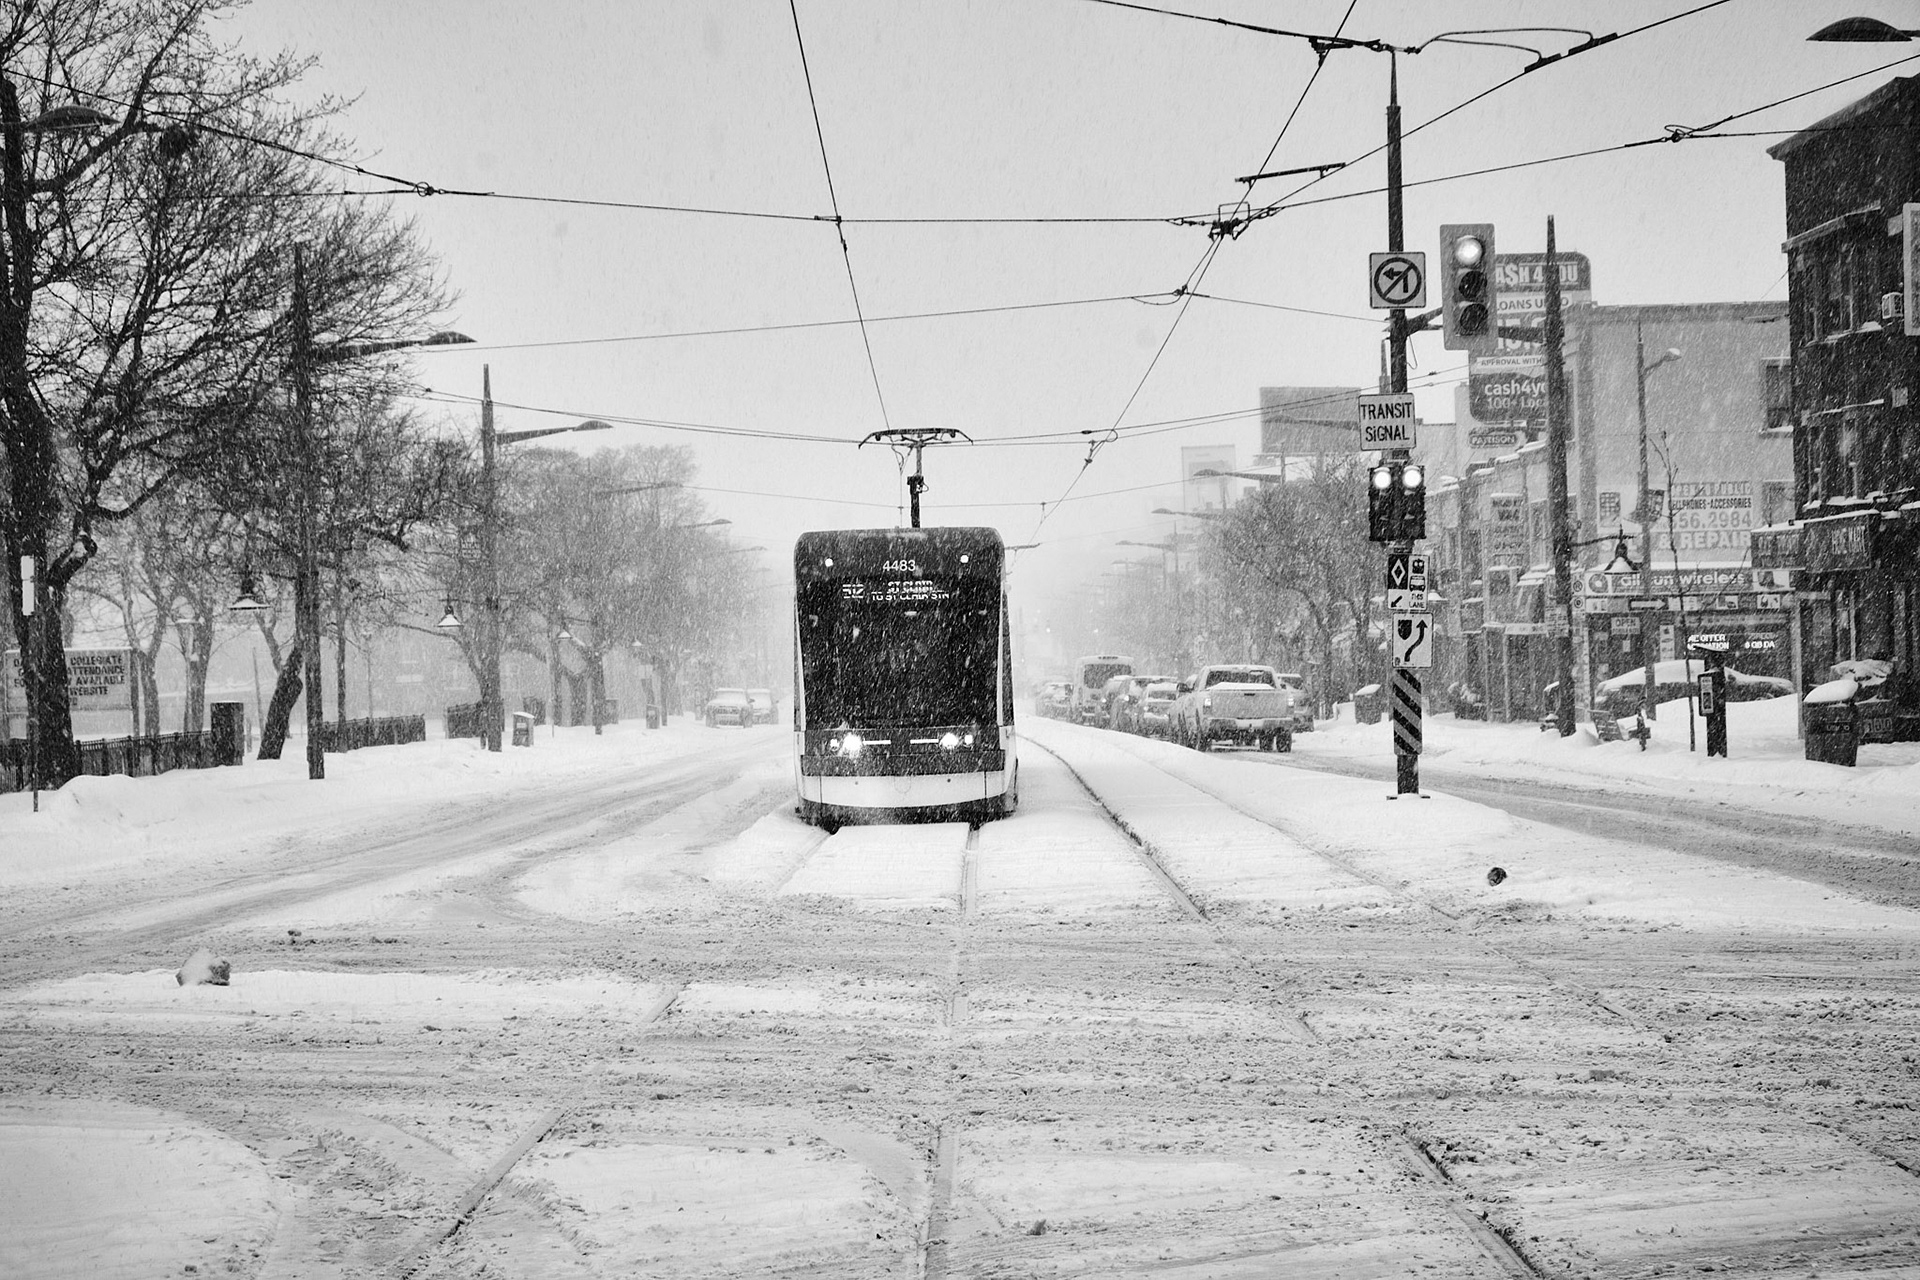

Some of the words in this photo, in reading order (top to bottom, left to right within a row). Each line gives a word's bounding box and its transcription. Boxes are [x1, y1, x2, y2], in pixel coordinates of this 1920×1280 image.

[1494, 263, 1530, 287] A$H
[1559, 263, 1578, 282] OU
[1497, 299, 1533, 311] OANS
[1481, 358, 1520, 366] APPROVAL
[1360, 401, 1412, 420] TRANSIT
[1681, 531, 1752, 550] REPAIR
[882, 559, 916, 572] 4483
[1615, 618, 1637, 629] OPEN
[70, 655, 123, 666] COLLEGIATE
[67, 665, 126, 676] ATTENDANCE
[75, 675, 126, 686] AVAILABLE
